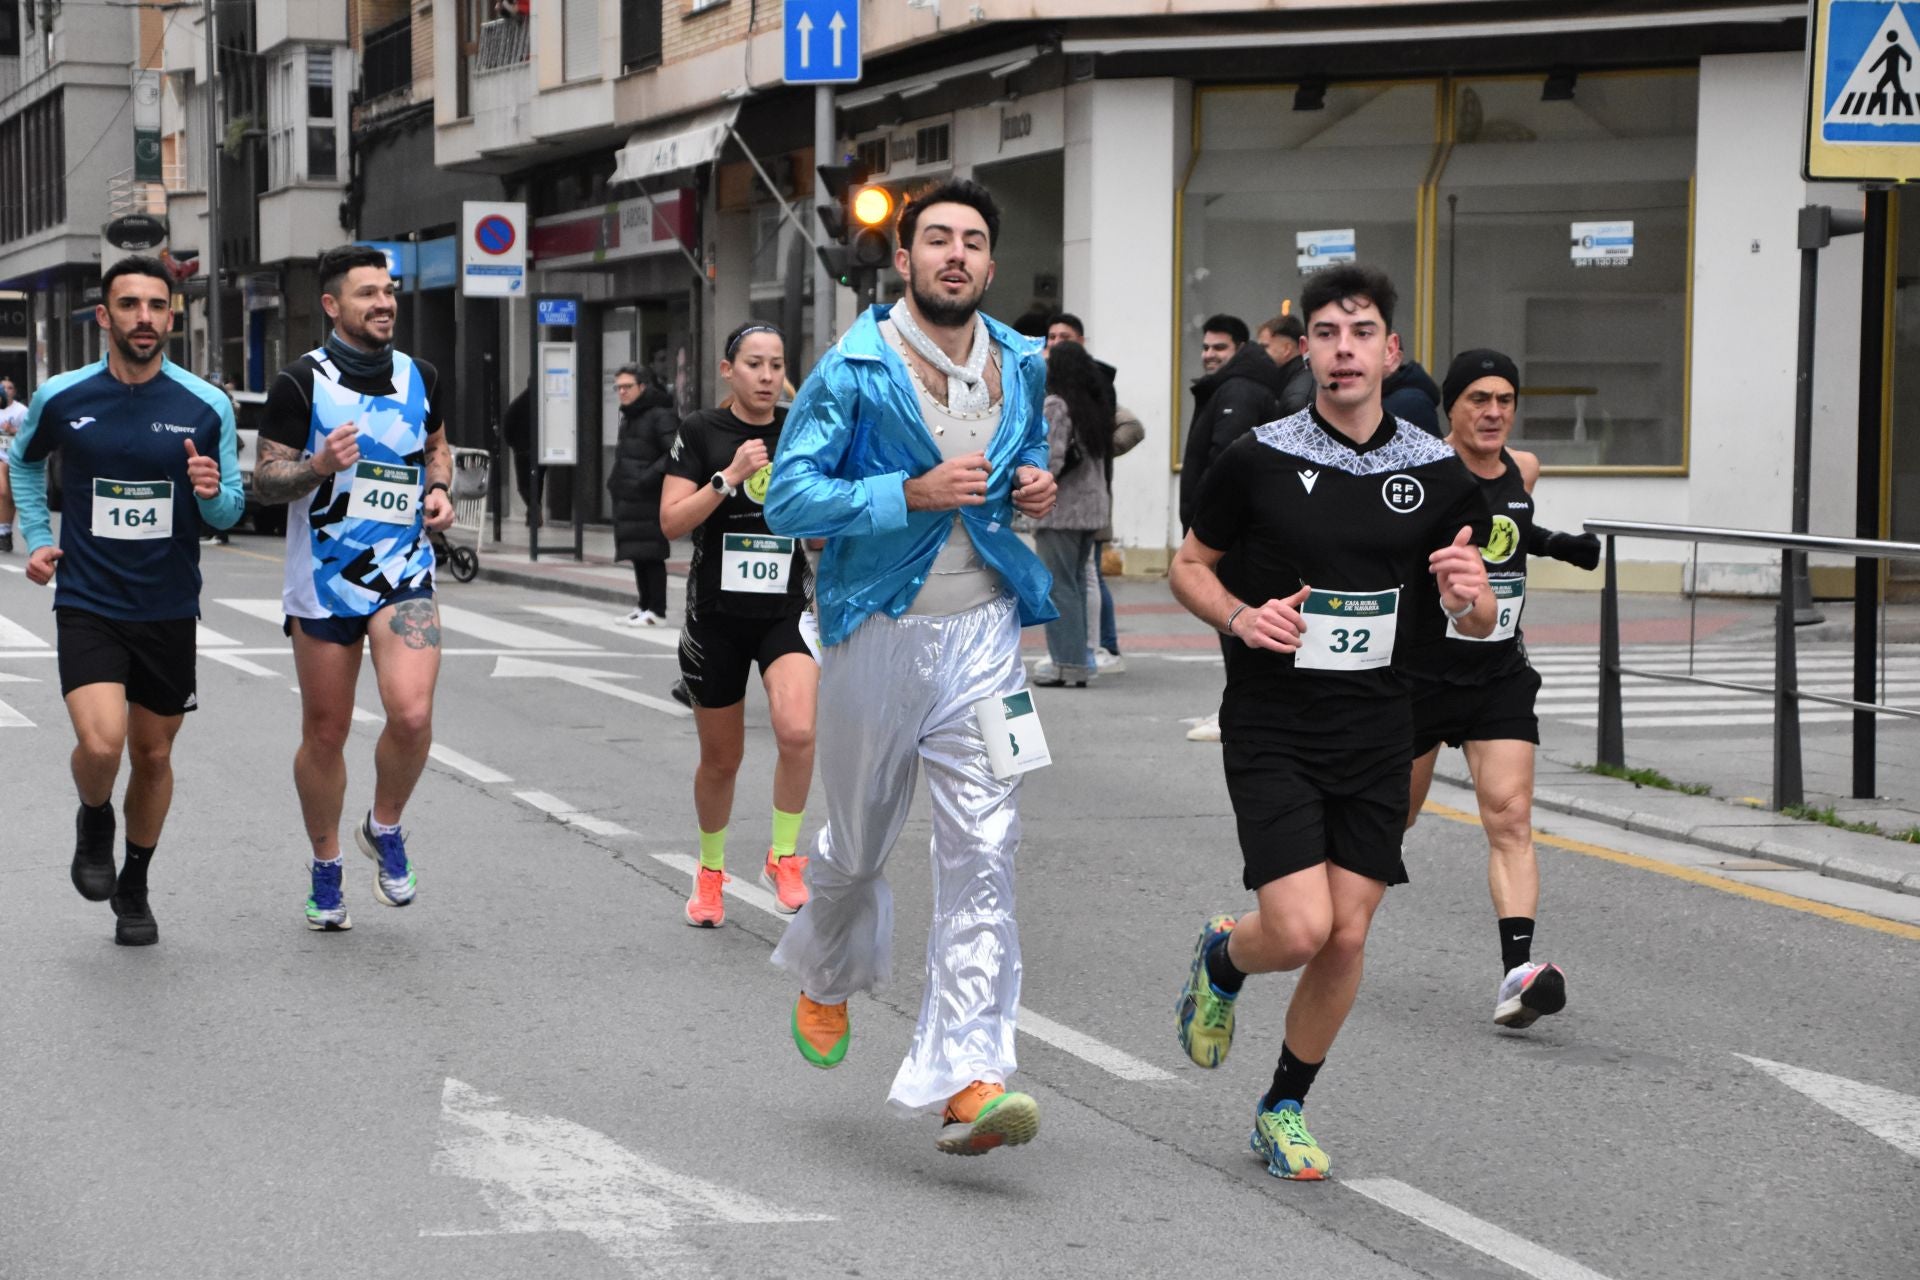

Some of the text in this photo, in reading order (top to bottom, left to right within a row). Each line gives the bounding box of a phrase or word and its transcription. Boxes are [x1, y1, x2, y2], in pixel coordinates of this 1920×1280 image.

[540, 301, 553, 311] 07
[164, 423, 196, 434] Viguera
[363, 489, 408, 511] 406
[109, 507, 157, 527] 164
[738, 561, 778, 580] 108
[1499, 607, 1511, 627] 6
[1328, 628, 1371, 653] 32
